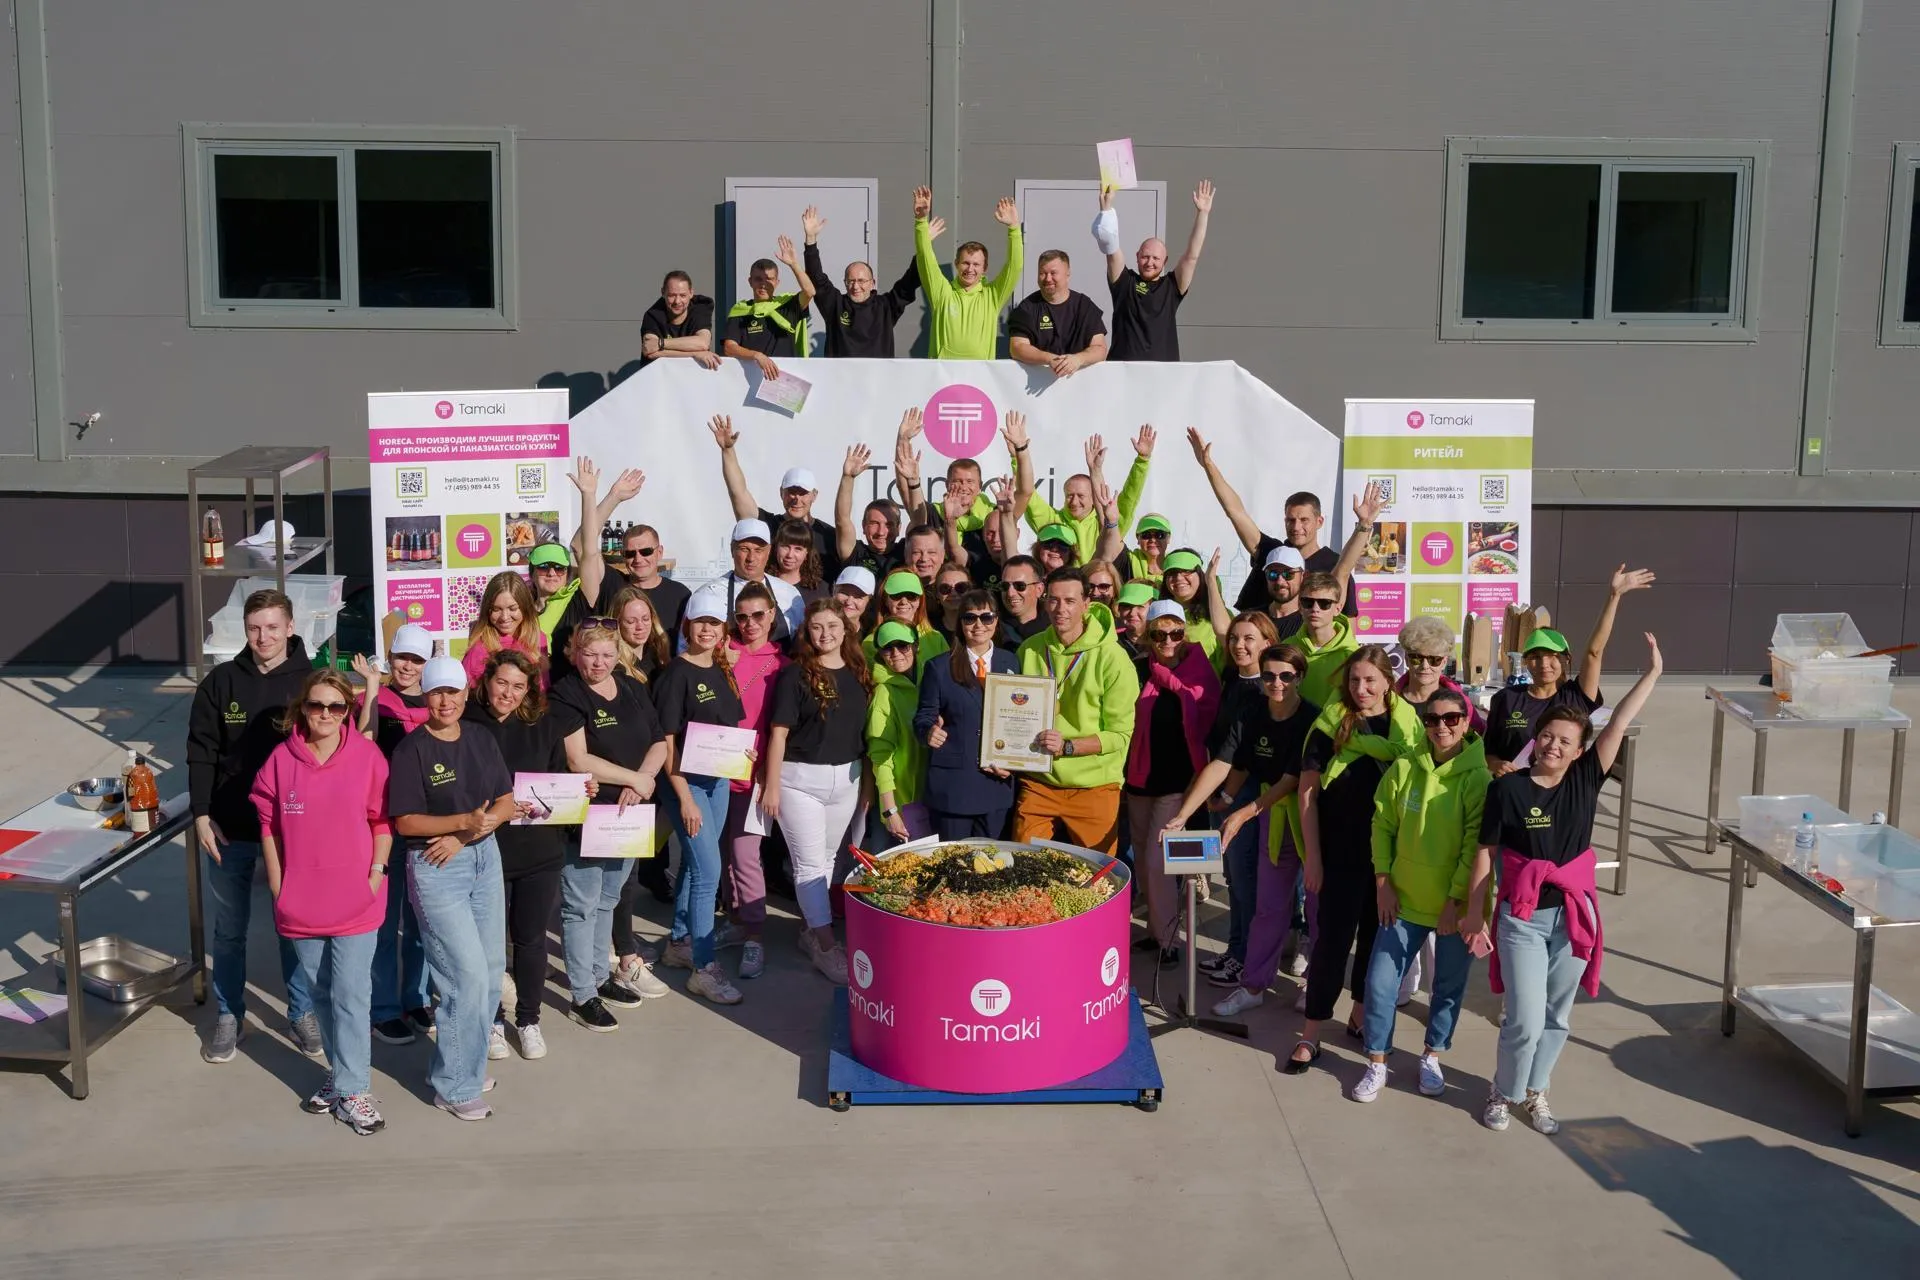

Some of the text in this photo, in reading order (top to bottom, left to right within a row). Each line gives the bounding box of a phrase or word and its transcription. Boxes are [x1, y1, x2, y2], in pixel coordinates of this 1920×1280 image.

[458, 403, 505, 415] Tamaki
[1429, 413, 1473, 426] Tamaki
[416, 436, 476, 445] ПРОИЗВОДИМ
[478, 434, 514, 442] ЛУЧШИЕ
[516, 433, 560, 442] ПРОДУКТЫ
[383, 447, 401, 456] ДЛЯ
[403, 445, 449, 454] ЯПОНСКОЙ
[460, 442, 526, 452] ПАНАЗИАТСКОЙ
[1414, 445, 1464, 458] РИТЕЙЛ
[411, 607, 422, 616] 12
[1524, 815, 1551, 824] Tamaki
[848, 985, 894, 1028] amaki
[940, 1016, 1040, 1042] Tamaki
